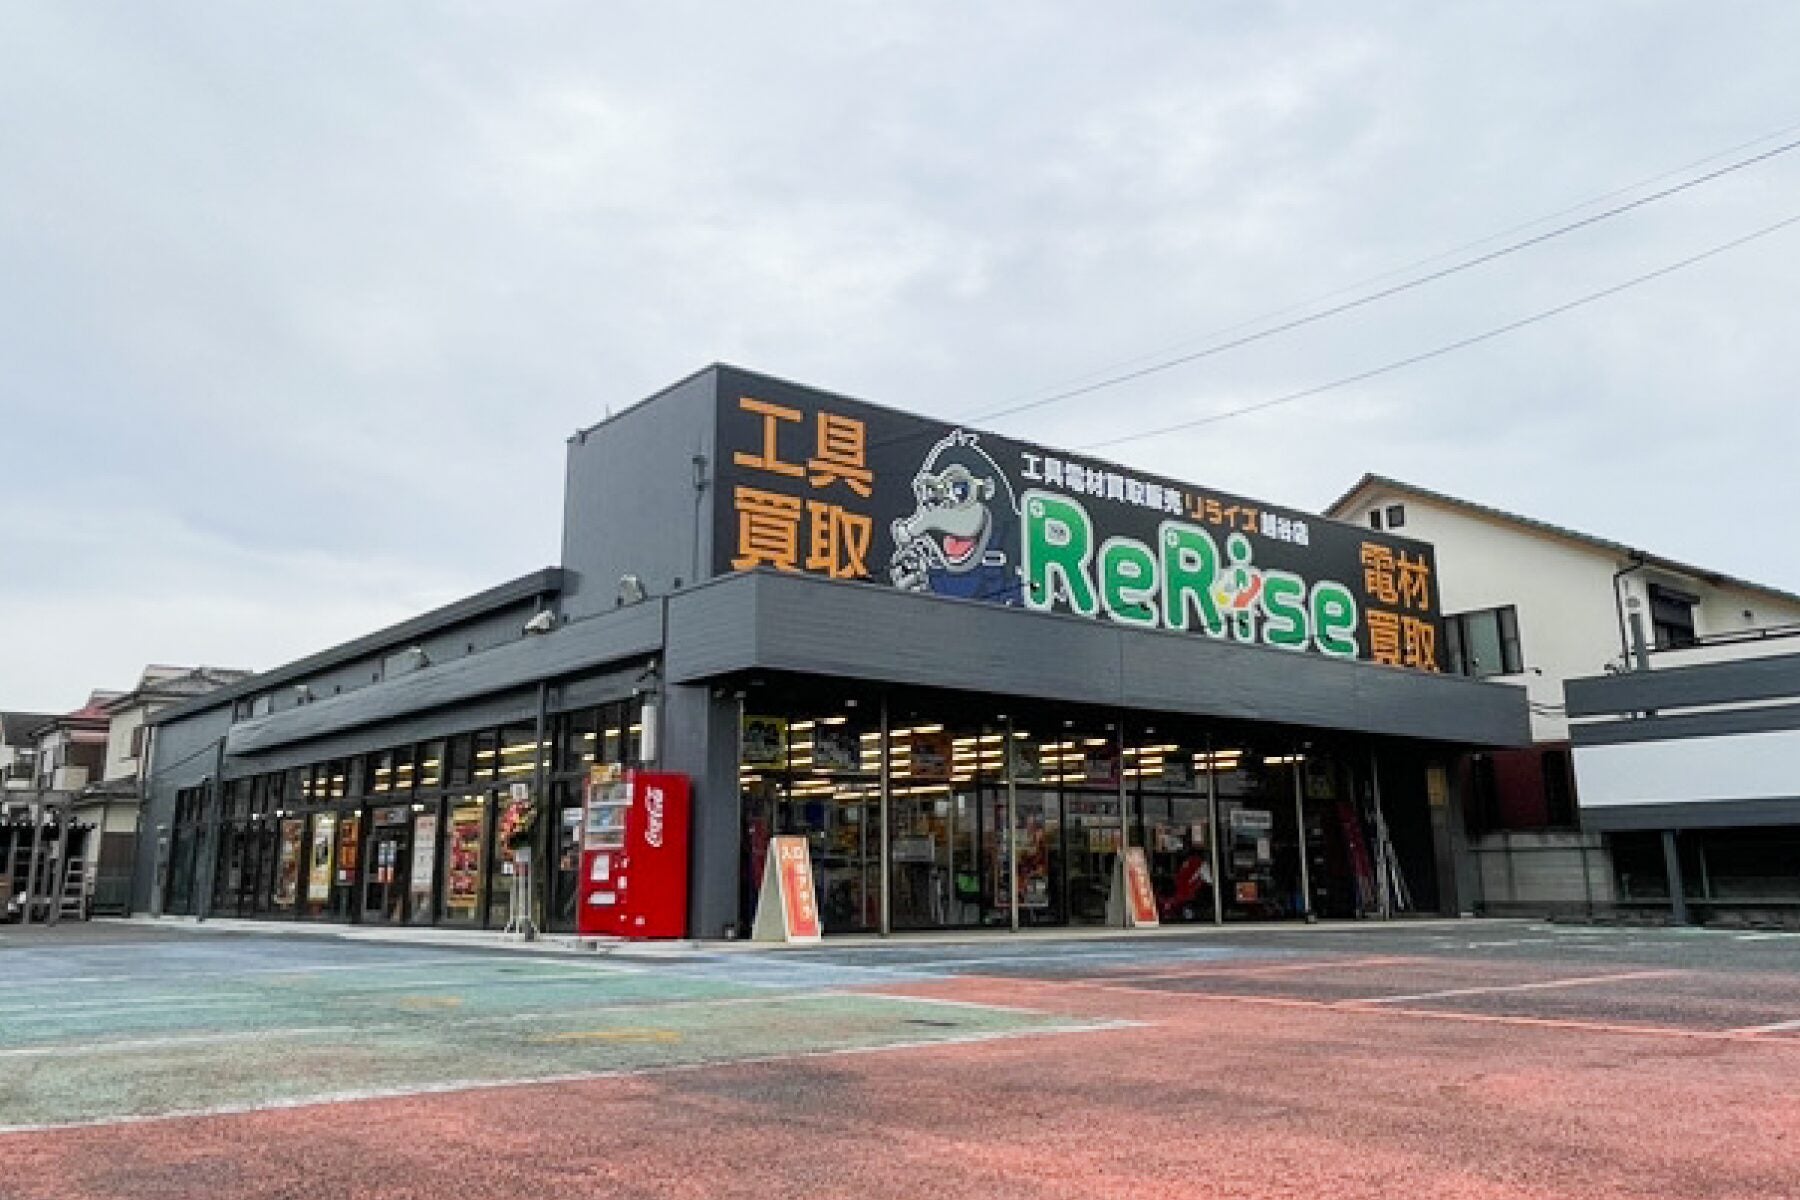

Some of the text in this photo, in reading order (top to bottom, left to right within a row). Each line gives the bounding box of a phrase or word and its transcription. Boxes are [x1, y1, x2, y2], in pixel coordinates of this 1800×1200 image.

[733, 398, 873, 497] 工具
[731, 485, 873, 579] 買取
[1022, 489, 1359, 660] ReRise
[1361, 541, 1429, 611] 電材
[1366, 609, 1440, 671] 買取
